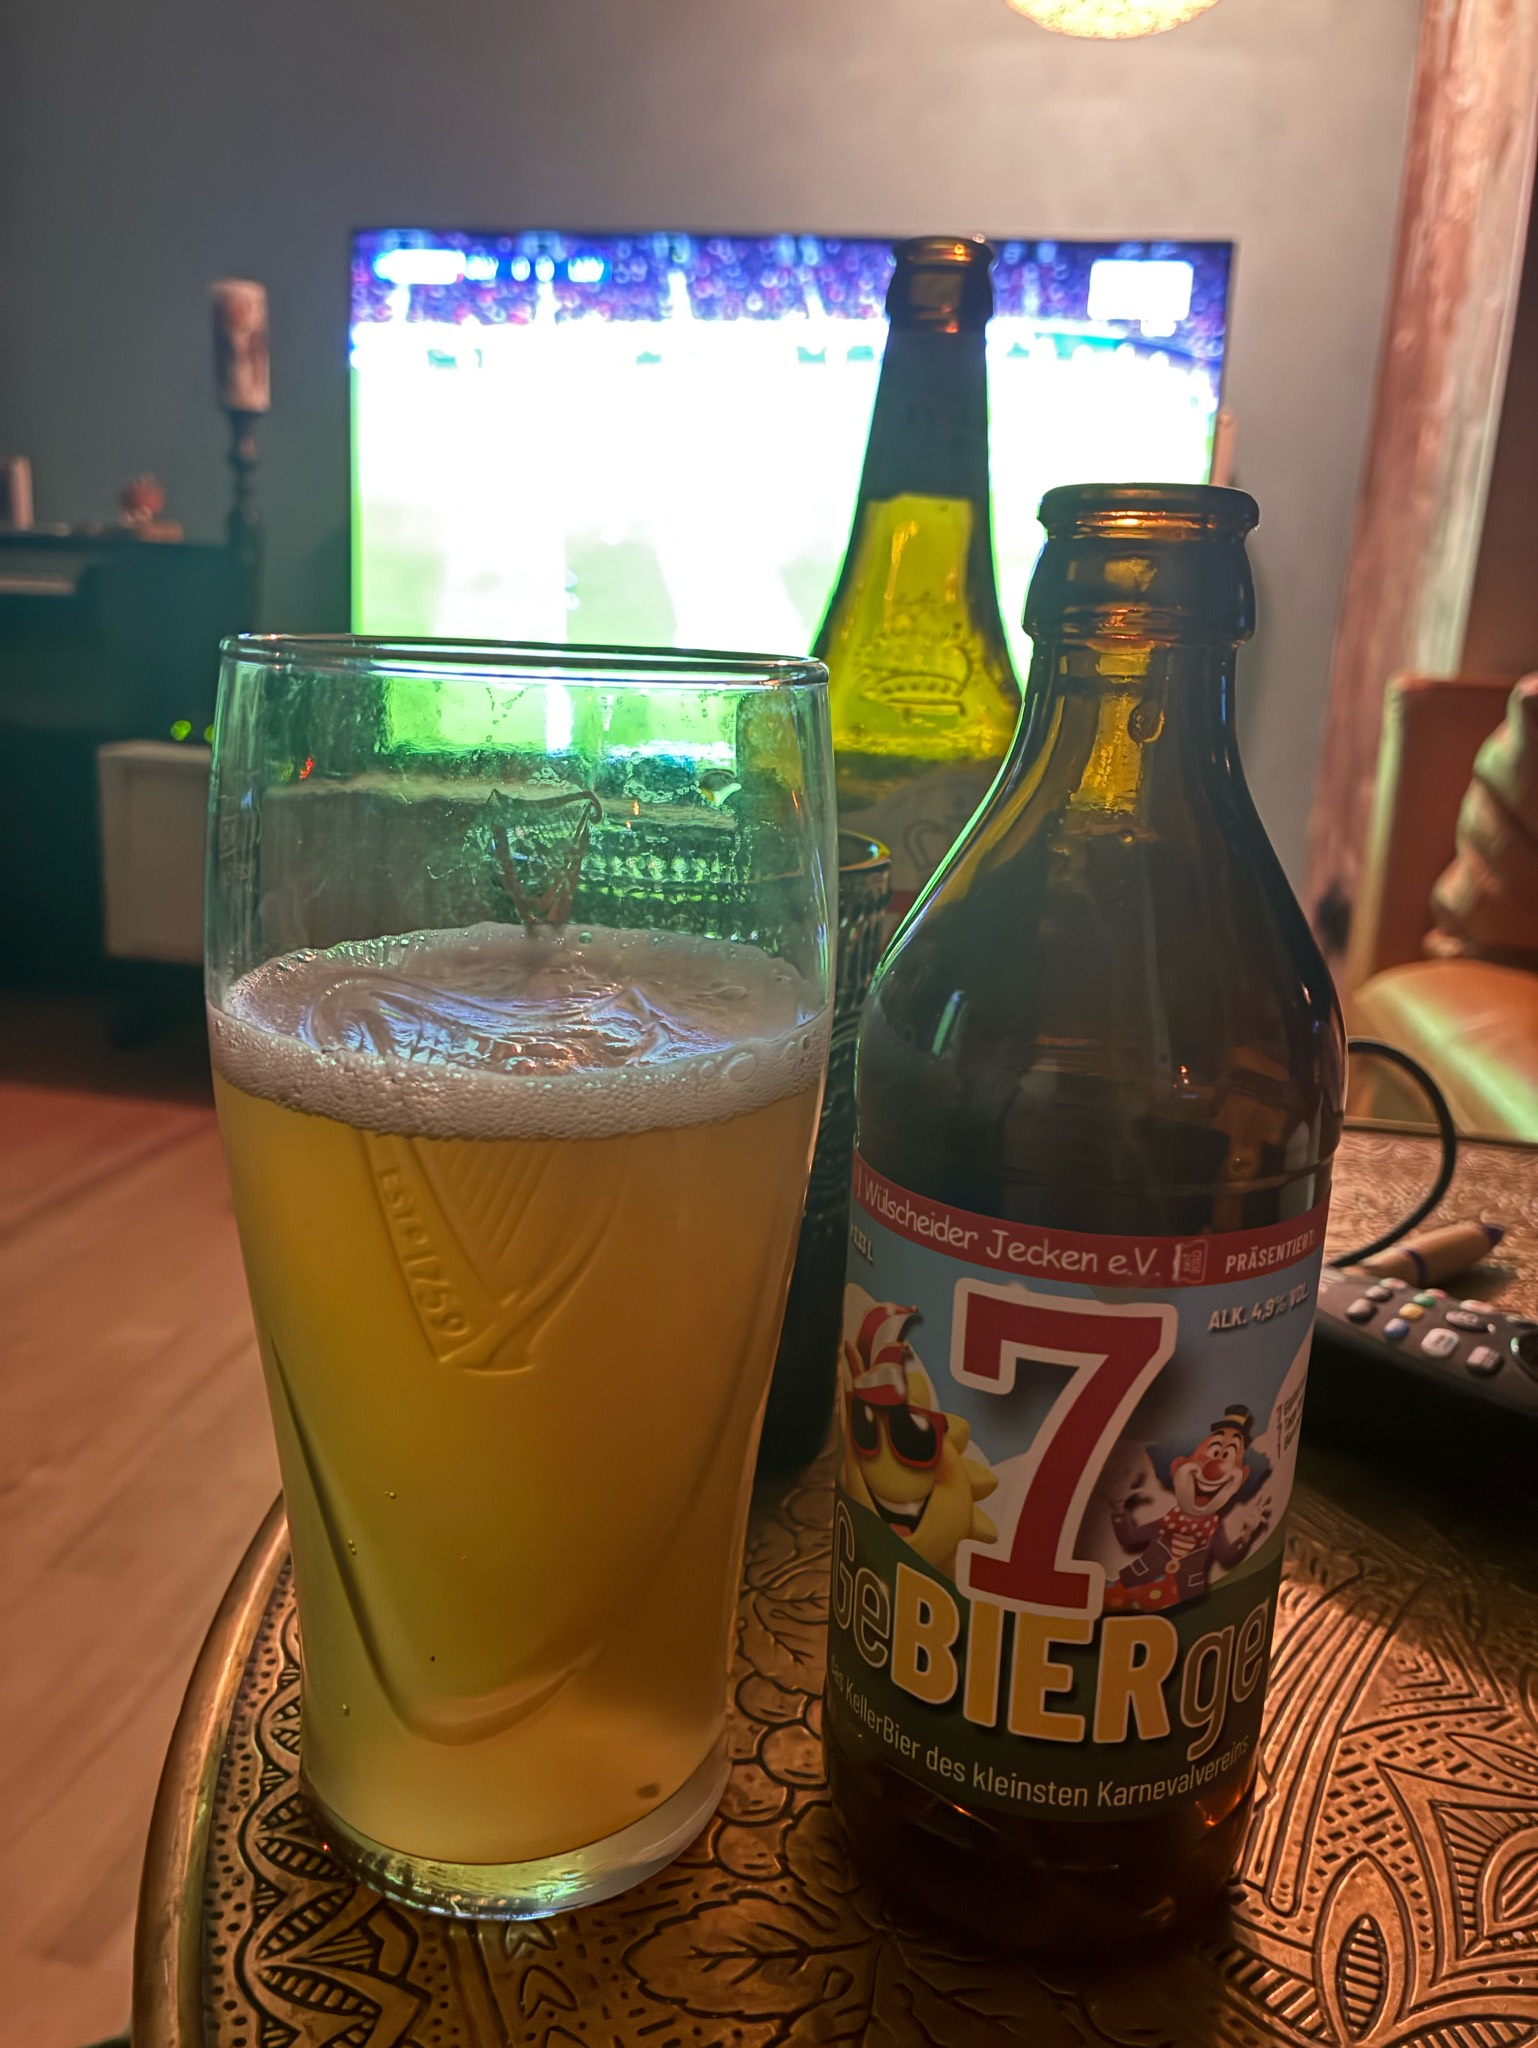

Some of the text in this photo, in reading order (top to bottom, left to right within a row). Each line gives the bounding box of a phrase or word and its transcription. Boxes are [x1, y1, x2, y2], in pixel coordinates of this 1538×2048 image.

[865, 1174, 979, 1251] Wülscheider
[986, 1228, 1099, 1275] Jecken
[1108, 1247, 1161, 1278] e.V.
[402, 1249, 470, 1338] 1759
[1208, 1307, 1250, 1333] ALK.
[1253, 1296, 1289, 1324] 4,9%
[949, 1277, 1178, 1621] 7
[832, 1499, 1271, 1762] GeBIERge
[845, 1679, 921, 1762] KellerBier
[926, 1745, 966, 1783] des
[972, 1761, 1089, 1809] kleinsten
[1096, 1733, 1251, 1808] Karnevalvereins
